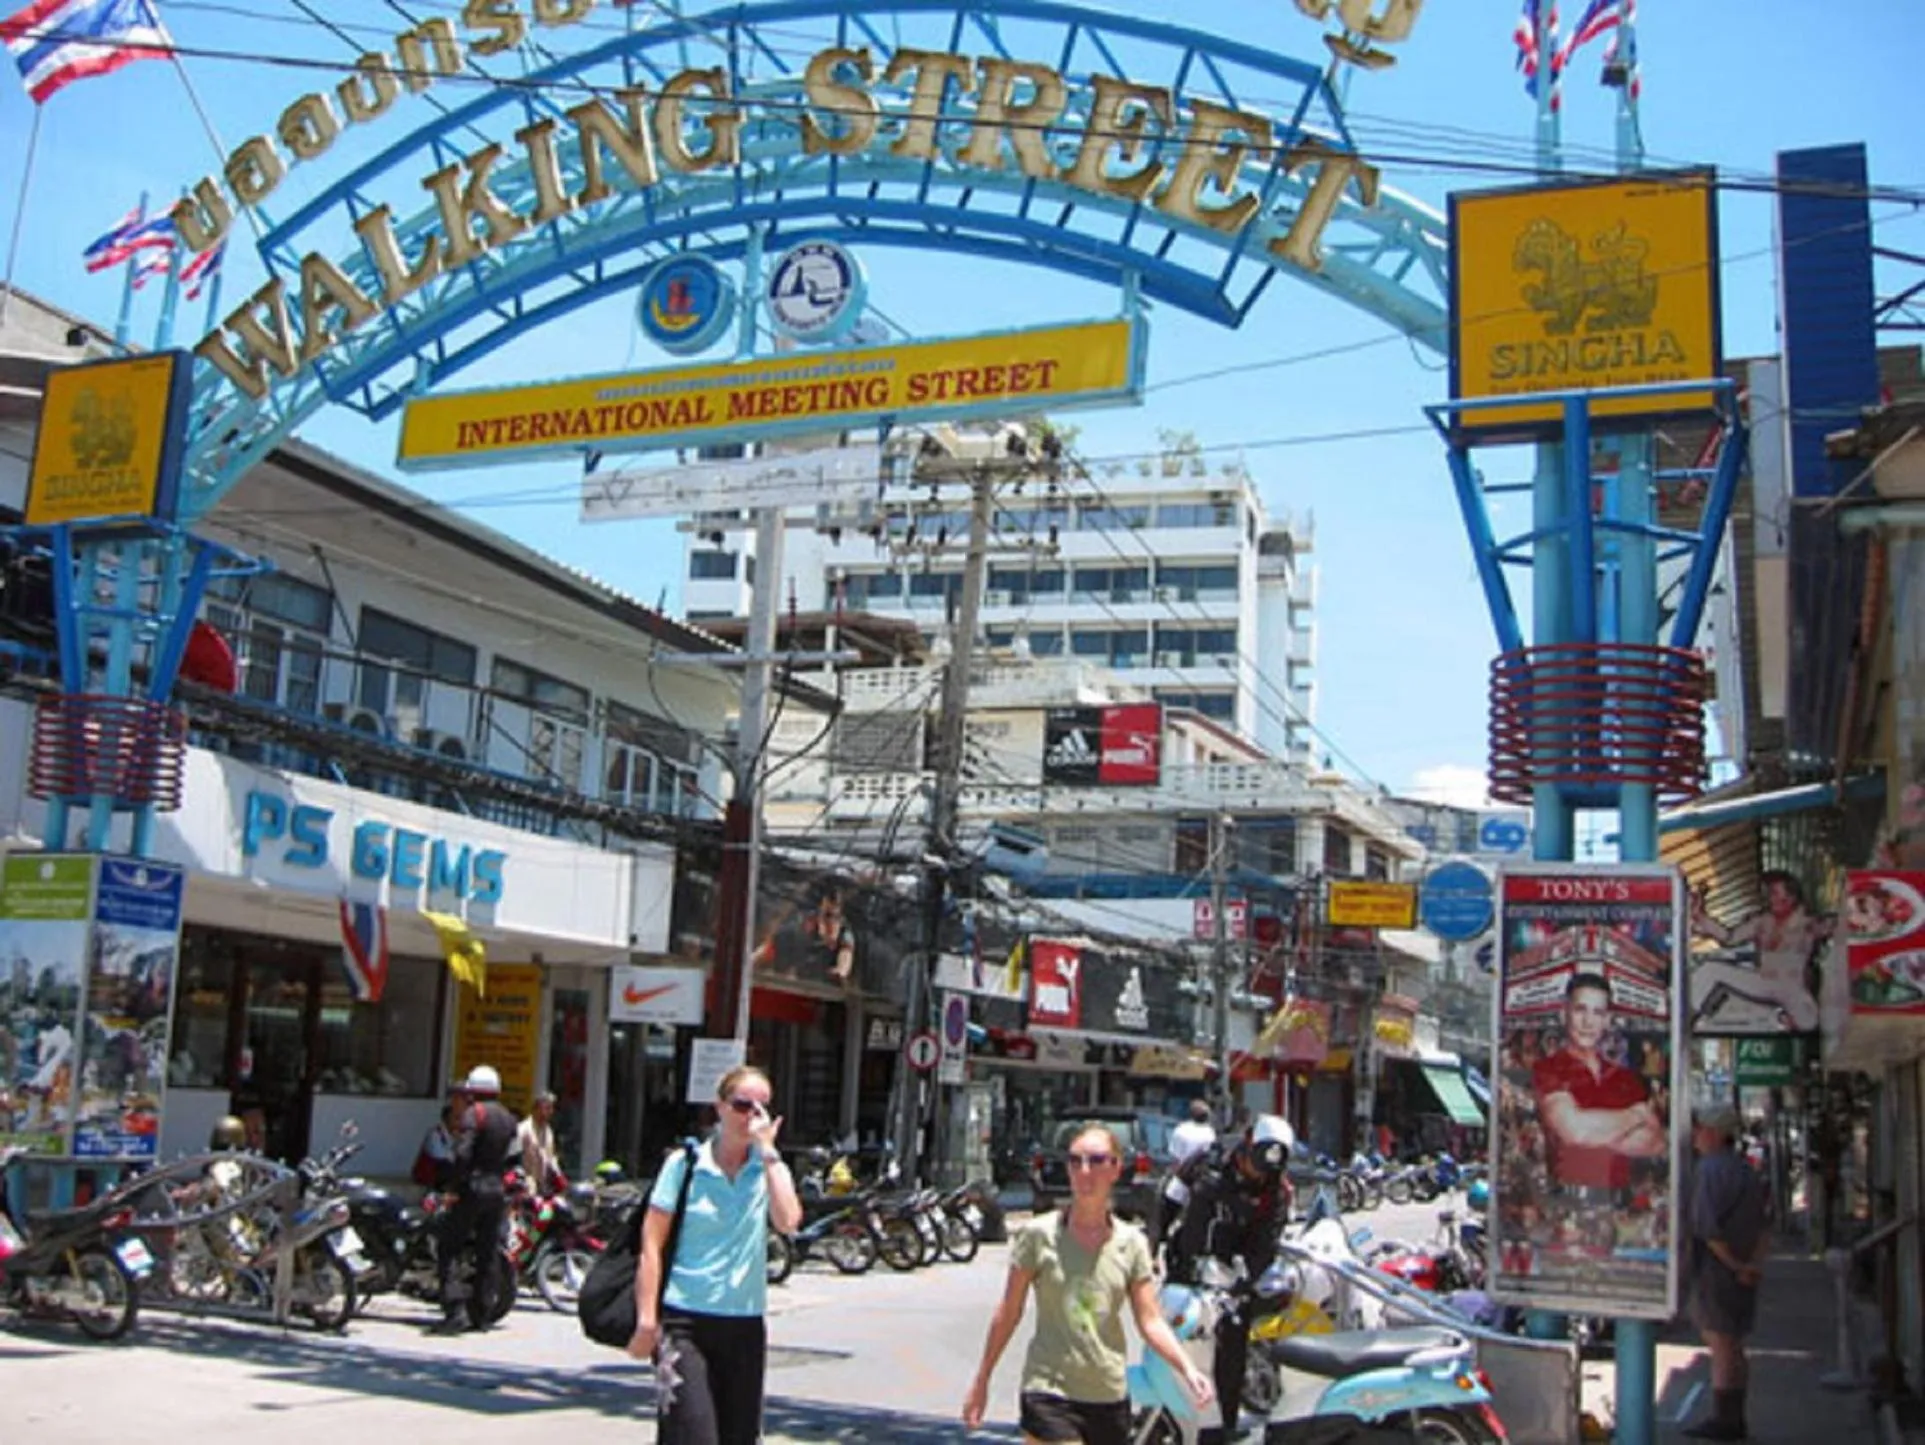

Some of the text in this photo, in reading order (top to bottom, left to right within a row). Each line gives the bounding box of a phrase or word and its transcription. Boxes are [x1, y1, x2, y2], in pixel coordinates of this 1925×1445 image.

[195, 48, 1381, 399] WALKING STREET
[1488, 329, 1686, 379] SINGHA
[455, 395, 714, 448] INTERNATIONAL
[729, 375, 889, 420] MEETING
[905, 360, 1060, 399] STREET
[242, 789, 509, 902] PS GEMS
[1537, 878, 1631, 900] TONY'S
